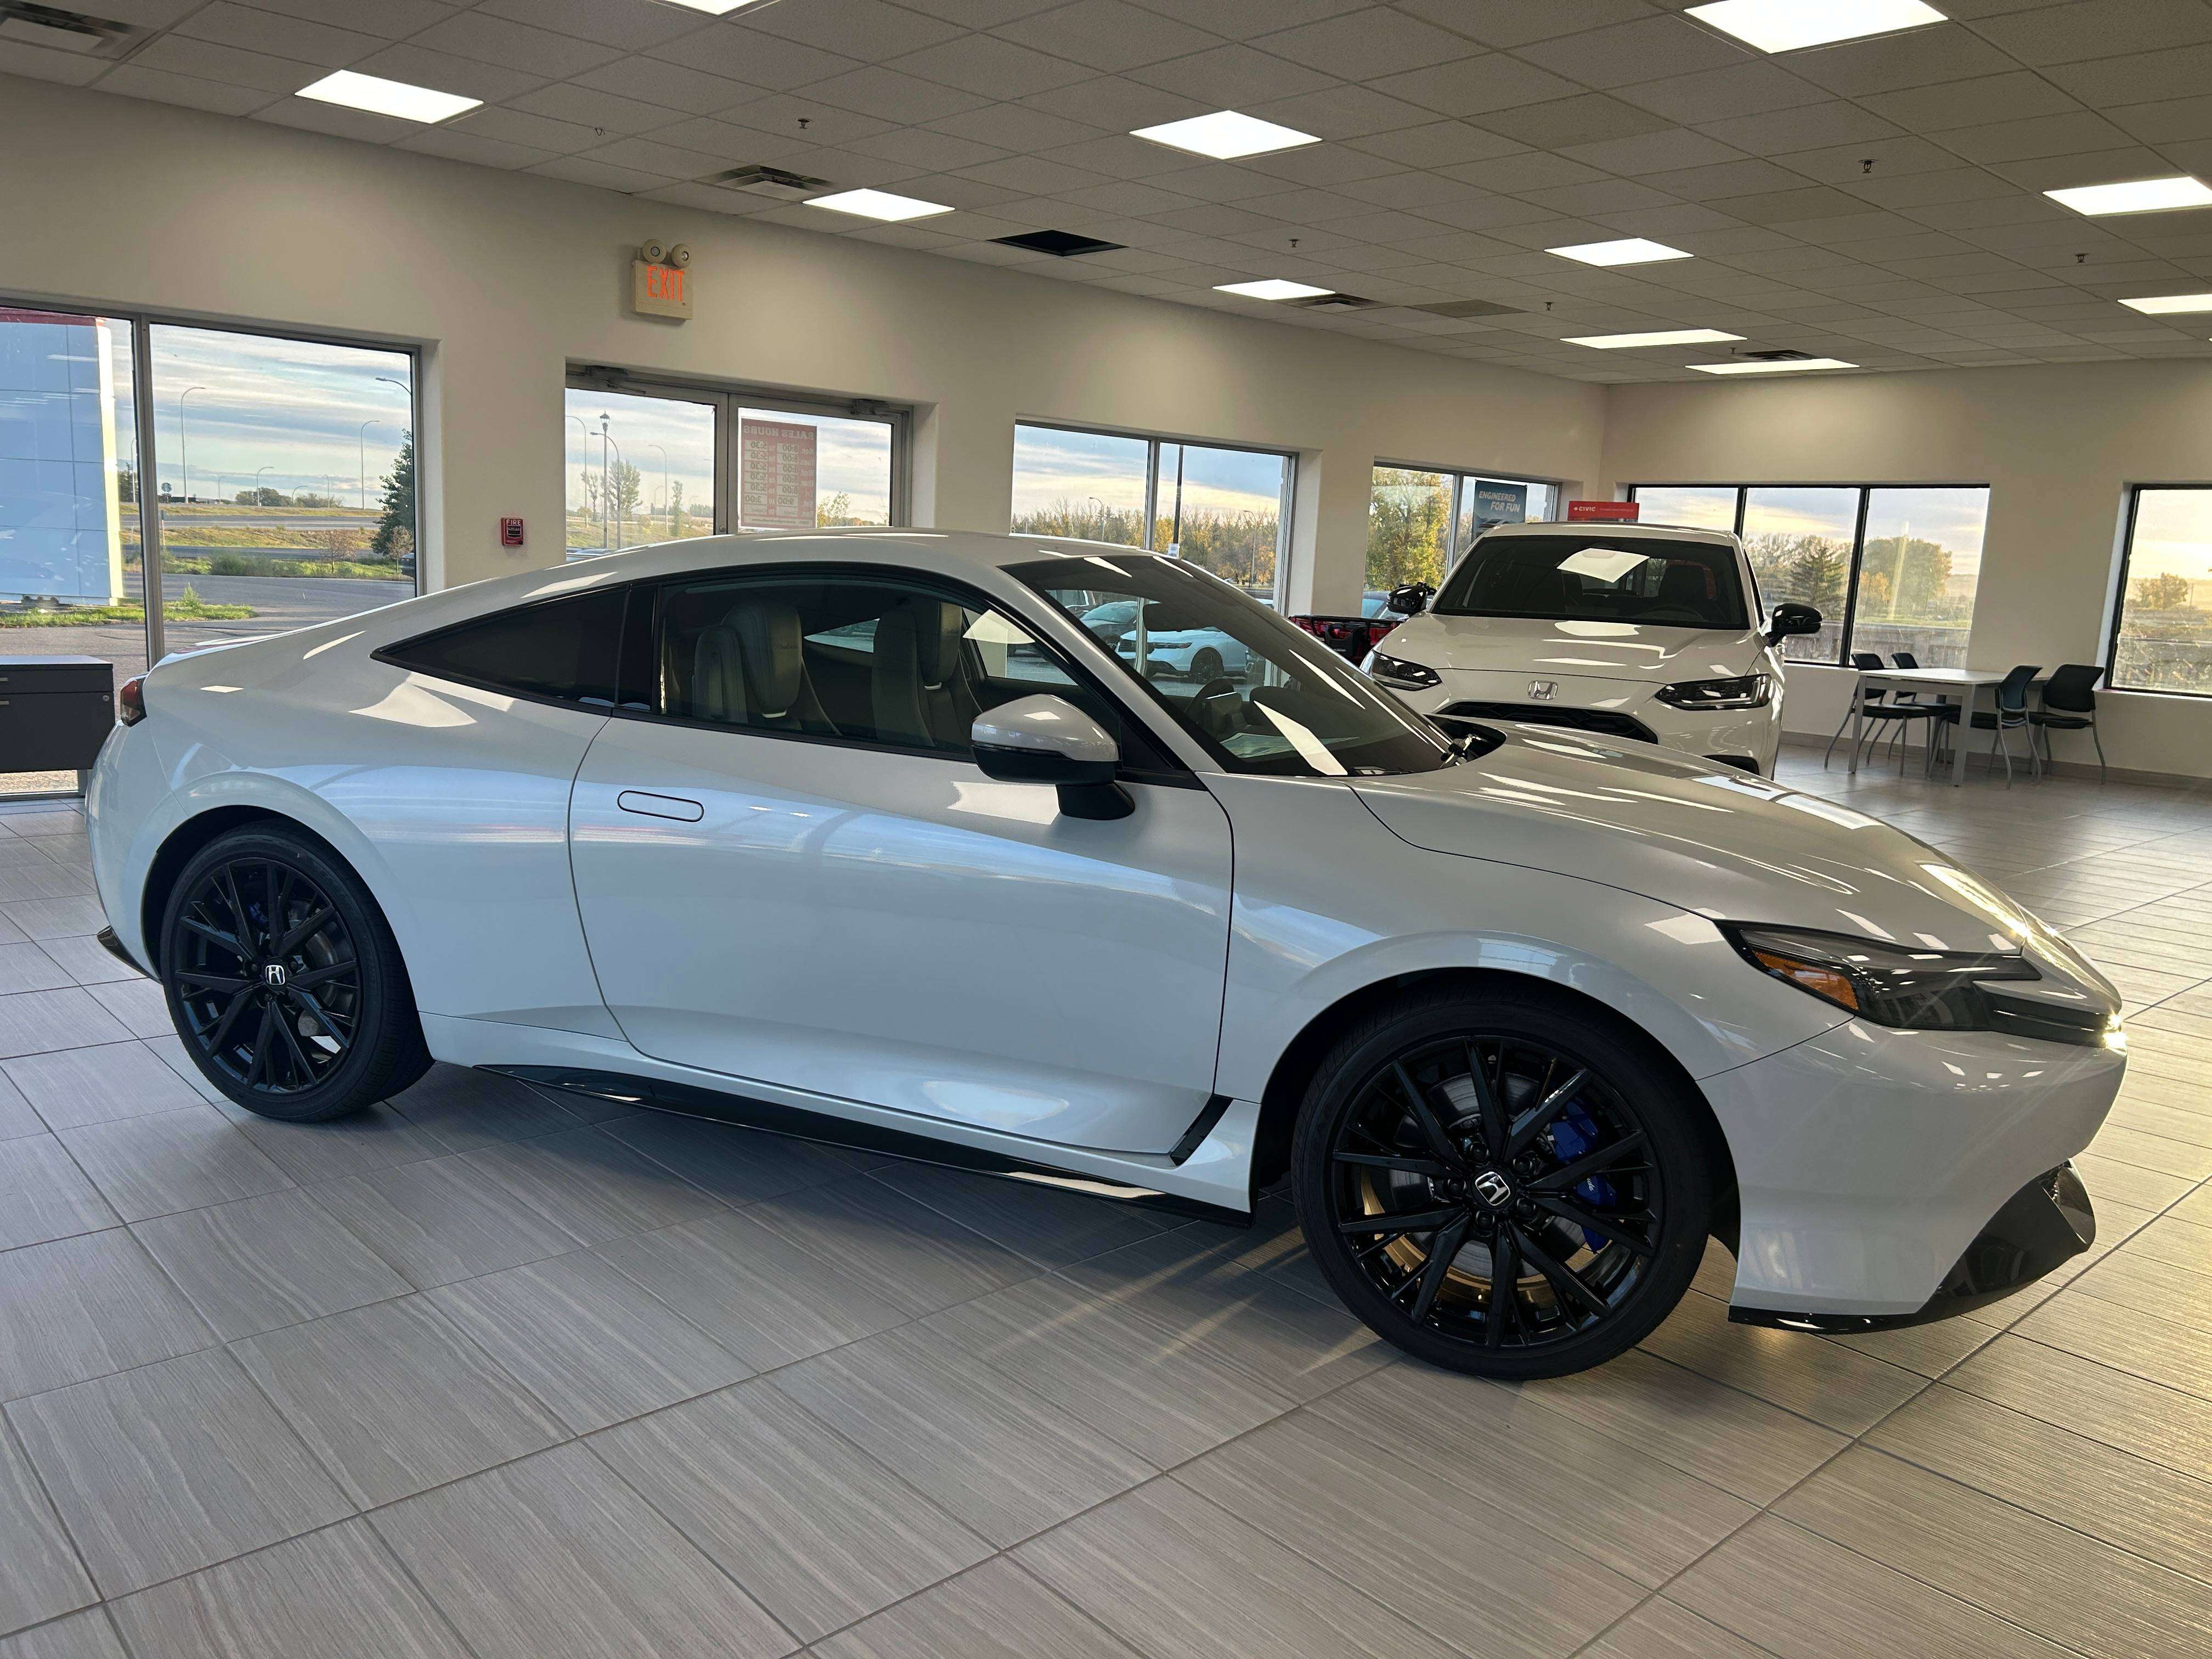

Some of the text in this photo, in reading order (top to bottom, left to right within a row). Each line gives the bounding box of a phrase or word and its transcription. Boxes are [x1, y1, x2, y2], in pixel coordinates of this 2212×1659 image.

[647, 265, 685, 301] EXIT
[1479, 490, 1516, 501] ENGINEERED
[1490, 501, 1520, 513] FOR FUN
